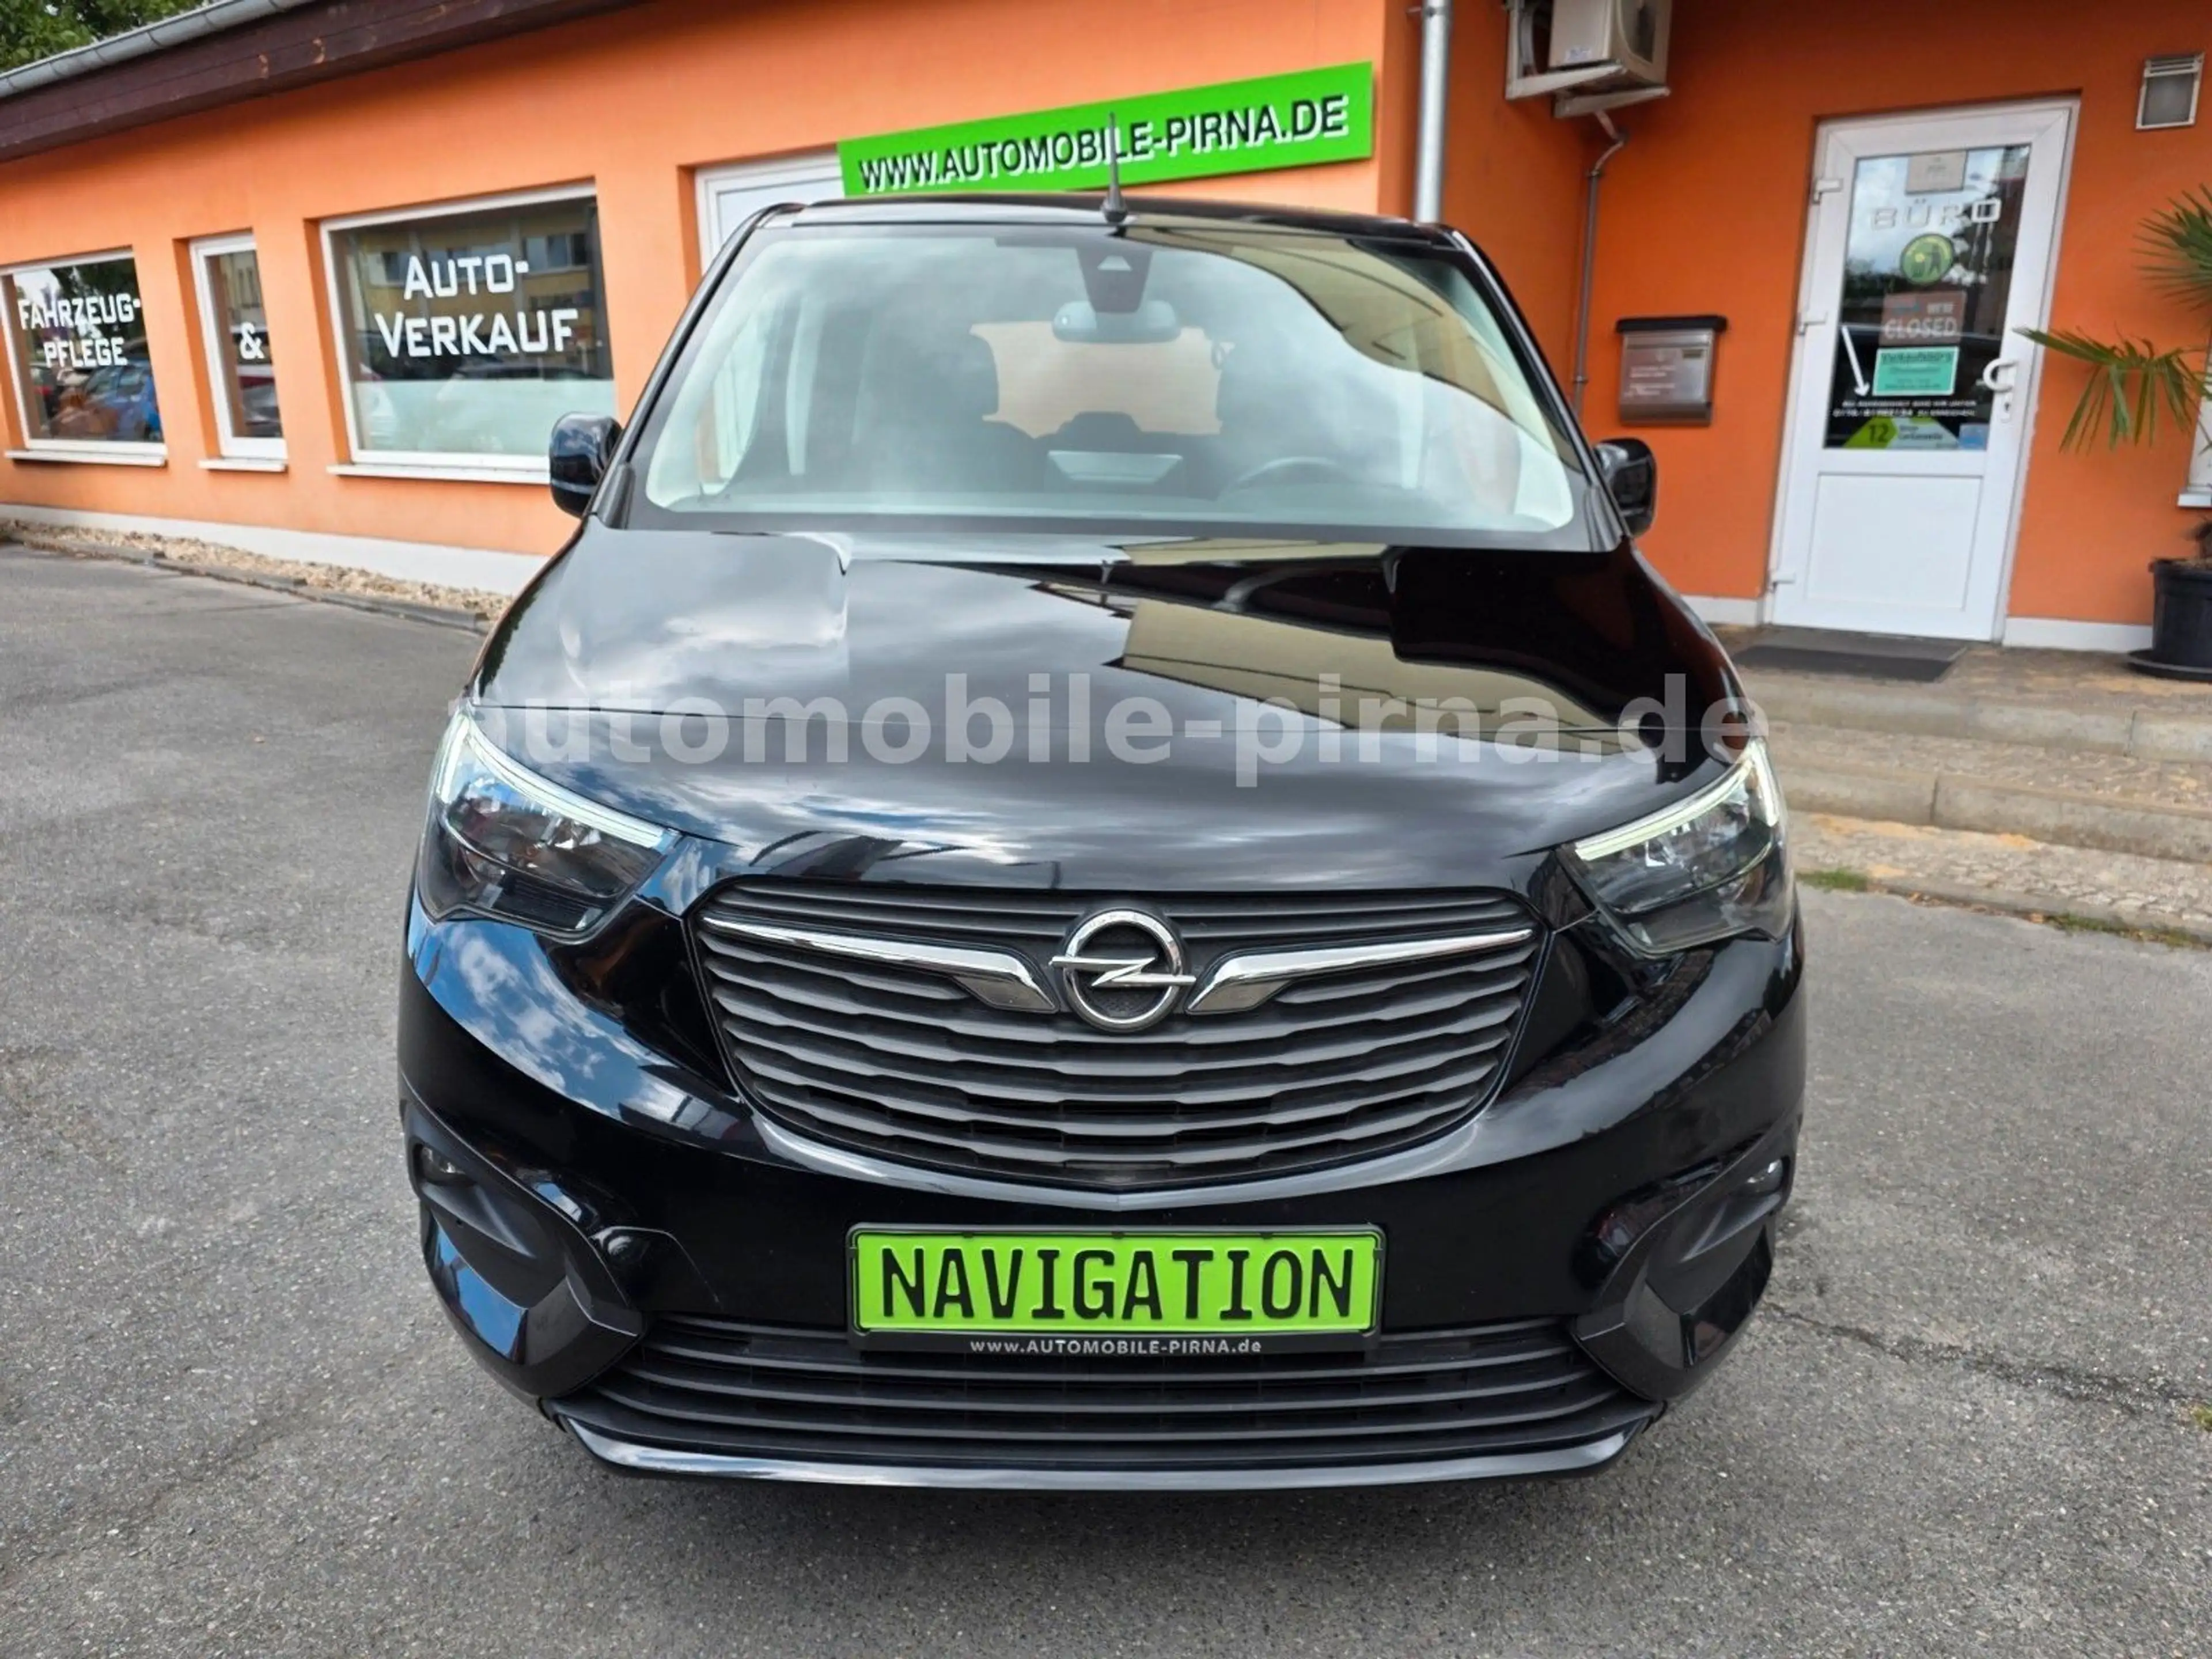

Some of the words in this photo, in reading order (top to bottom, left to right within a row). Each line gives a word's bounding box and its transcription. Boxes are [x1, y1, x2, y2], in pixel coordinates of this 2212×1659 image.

[858, 94, 1349, 192] WWW.AUTOMOBILE-PIRNA.DE
[1872, 198, 2002, 229] BÜRO
[403, 253, 529, 299] AUTO-
[17, 293, 141, 330] FAHRZEUG-
[1884, 317, 1958, 339] CLOSED
[43, 336, 128, 368] PFLEGE
[239, 322, 263, 359] &
[375, 309, 578, 358] VERKAUF
[1869, 423, 1889, 443] 12
[881, 1247, 1354, 1320] NAVIGATION
[969, 1339, 1262, 1355] www.AUTOMOBILE-PIRNA.de
